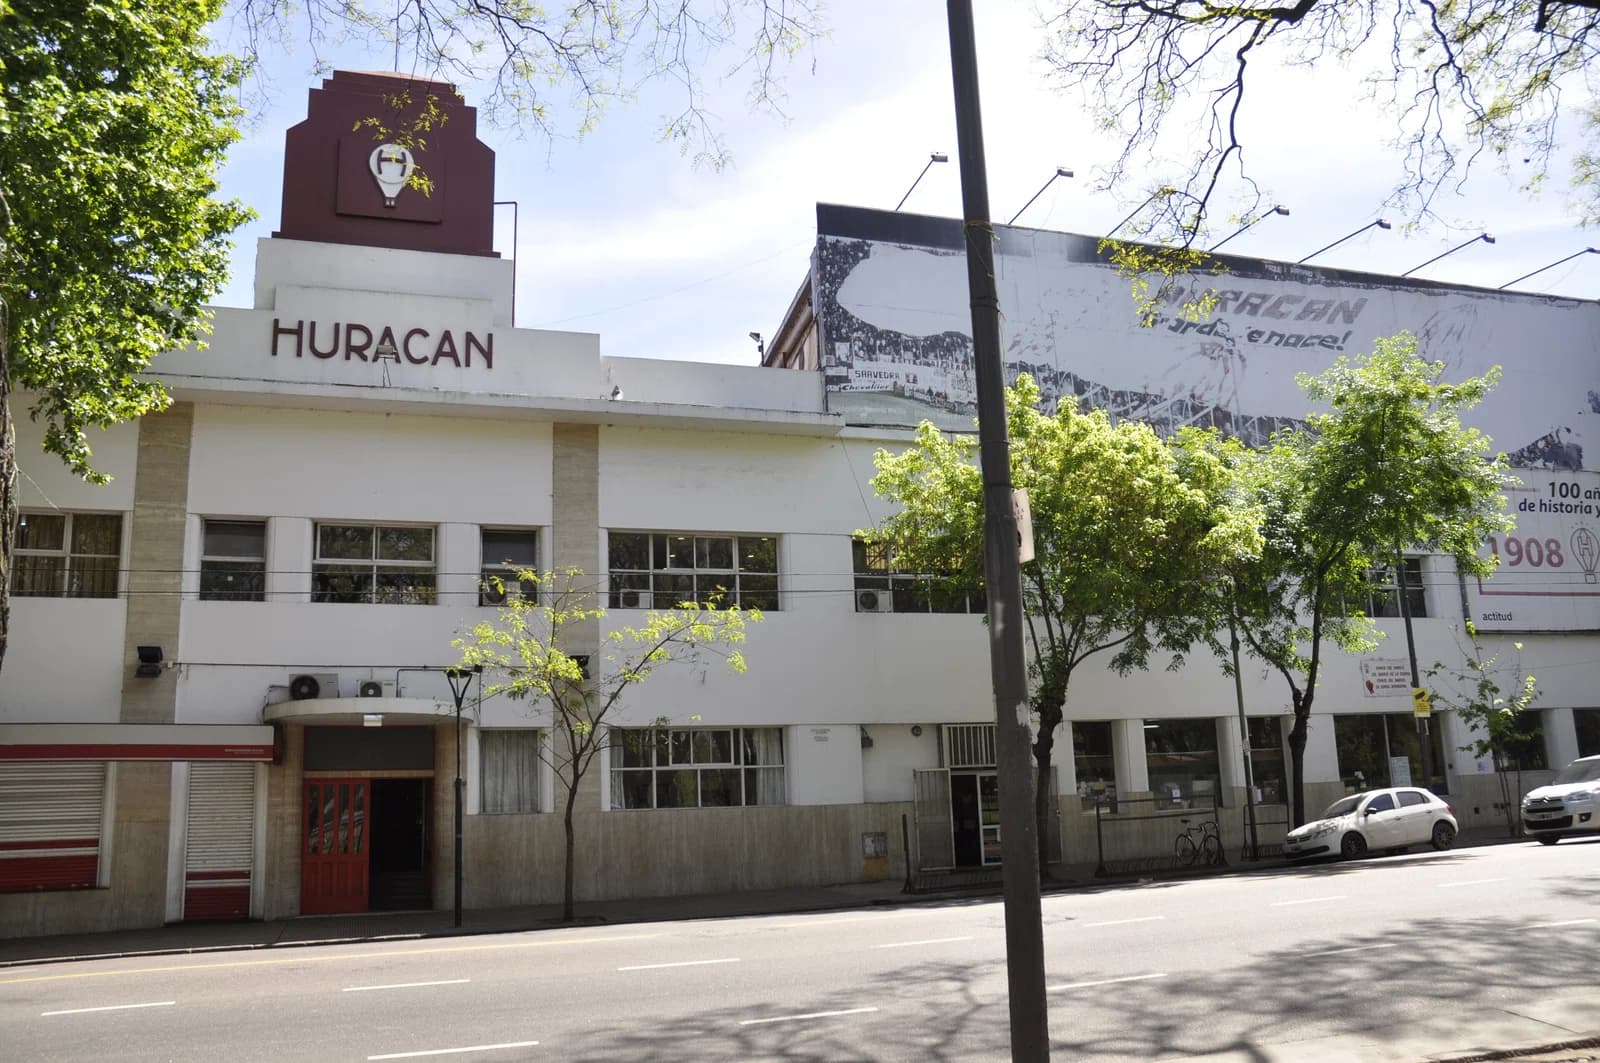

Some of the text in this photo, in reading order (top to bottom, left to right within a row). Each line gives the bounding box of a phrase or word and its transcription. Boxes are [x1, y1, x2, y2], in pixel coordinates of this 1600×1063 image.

[271, 318, 494, 369] HURACAN
[1549, 482, 1580, 498] 100
[1518, 498, 1536, 512] de
[1540, 499, 1592, 514] historia
[1488, 536, 1564, 568] 1908
[1482, 611, 1513, 621] actitud
